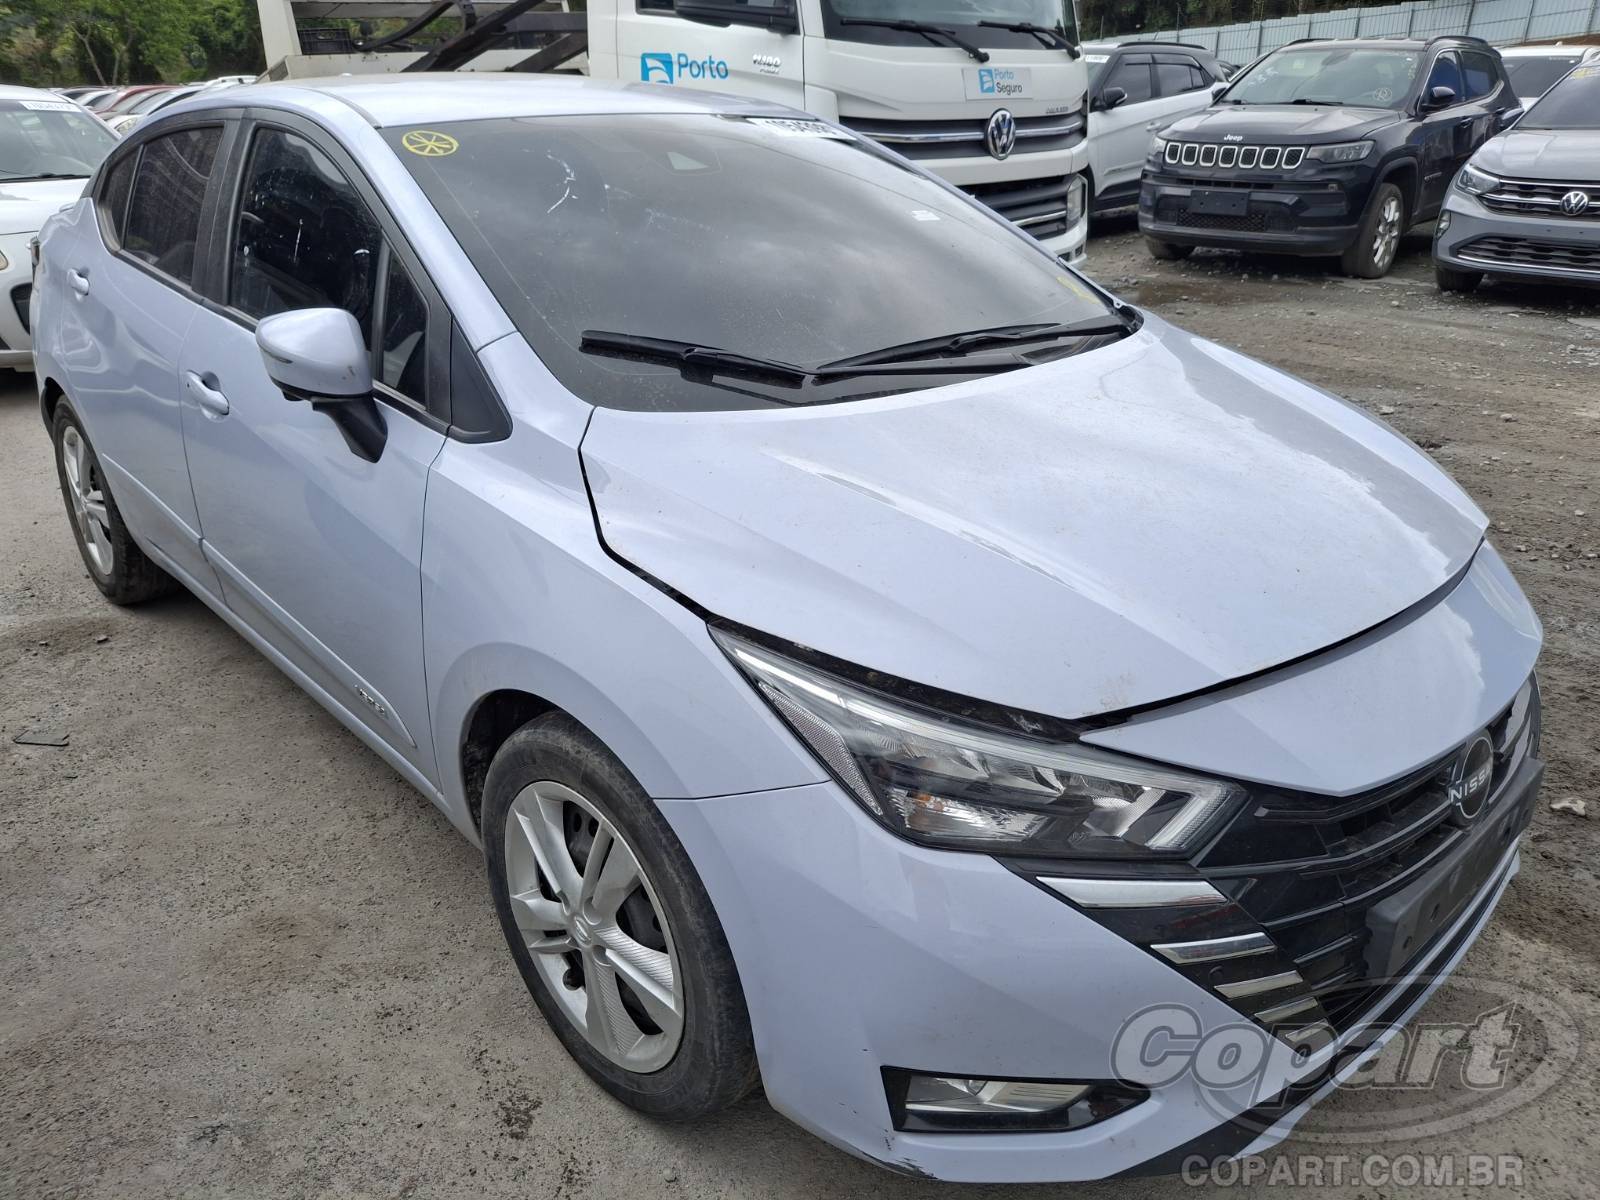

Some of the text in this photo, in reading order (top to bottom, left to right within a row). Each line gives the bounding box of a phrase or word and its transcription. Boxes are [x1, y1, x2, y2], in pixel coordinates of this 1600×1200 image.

[677, 52, 729, 80] Porto
[994, 68, 1015, 80] Porto
[996, 82, 1023, 95] Seguro
[1223, 134, 1243, 142] Jeep
